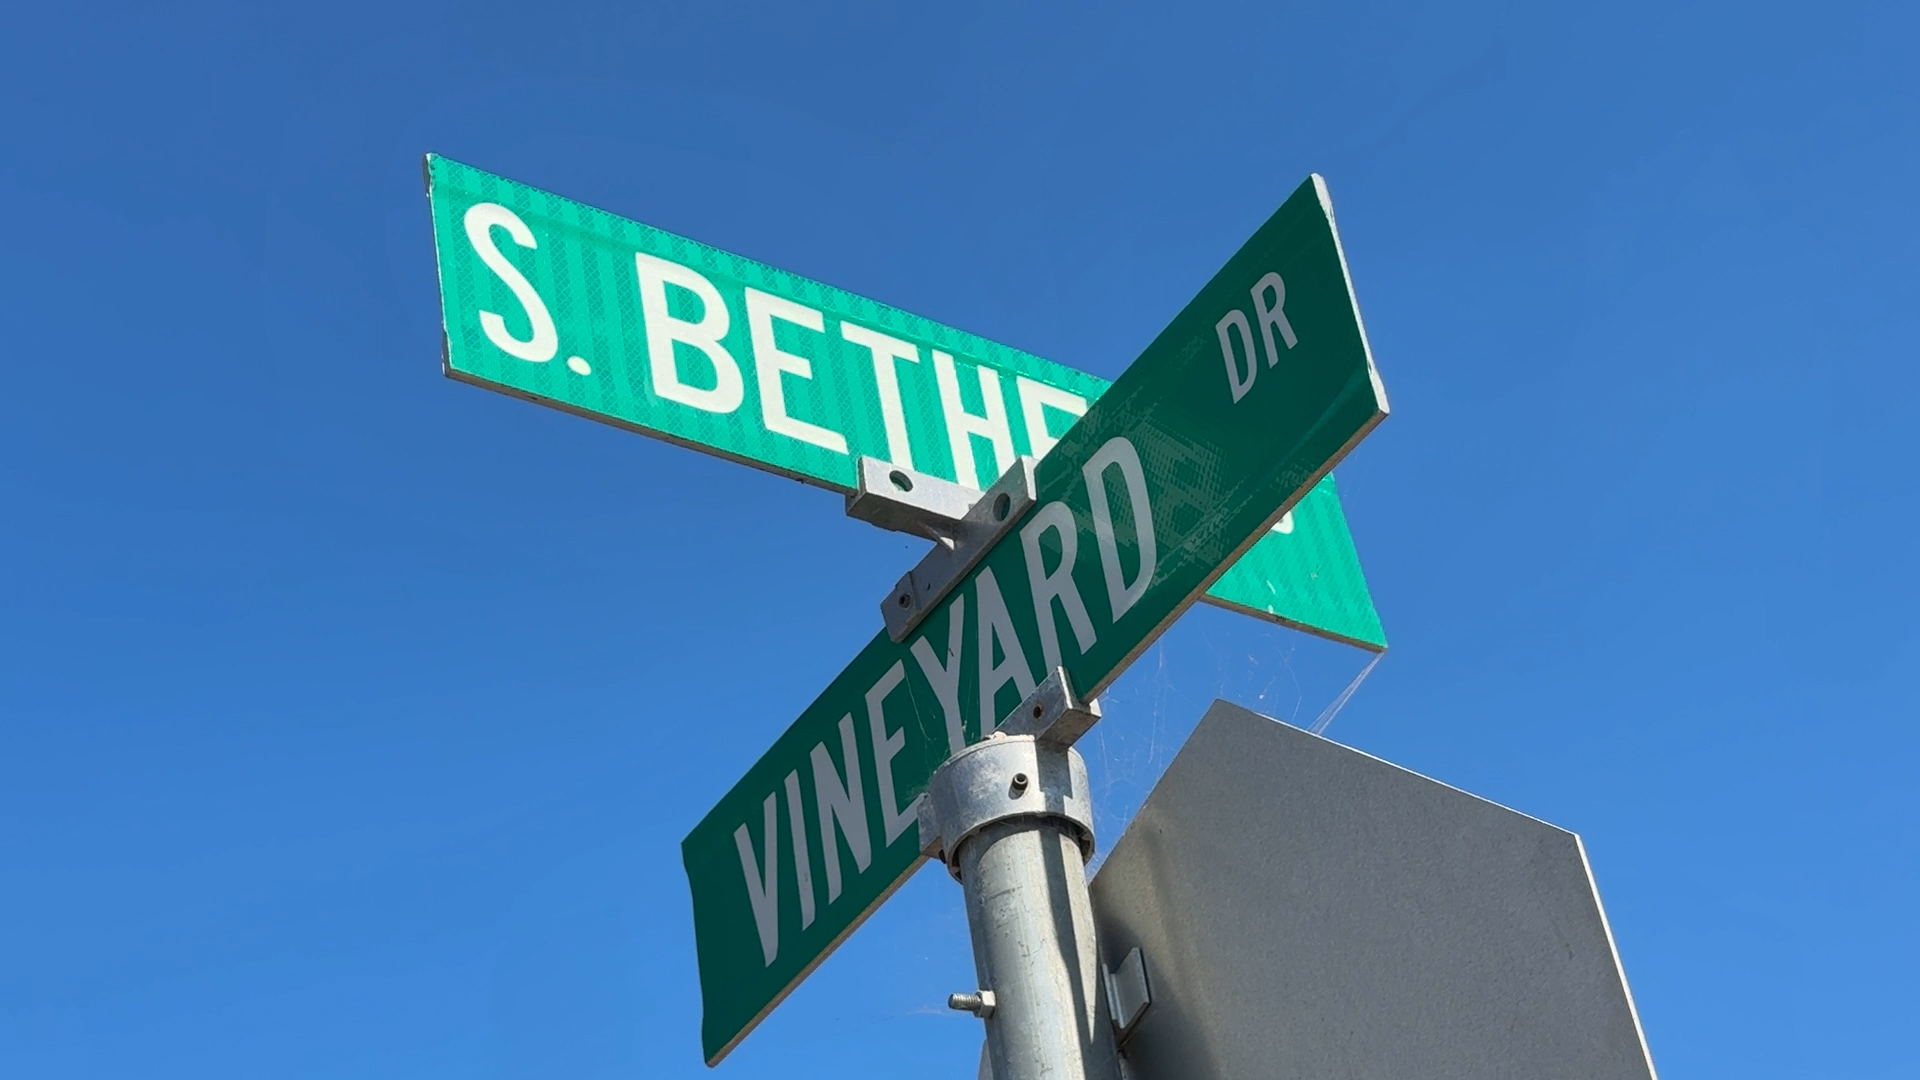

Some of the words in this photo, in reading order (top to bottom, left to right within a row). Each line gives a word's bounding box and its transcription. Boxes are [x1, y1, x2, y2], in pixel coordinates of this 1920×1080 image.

[464, 202, 591, 376] S.
[635, 252, 1088, 492] BETHE
[733, 436, 1157, 968] VINEYARD
[1216, 271, 1298, 404] DR
